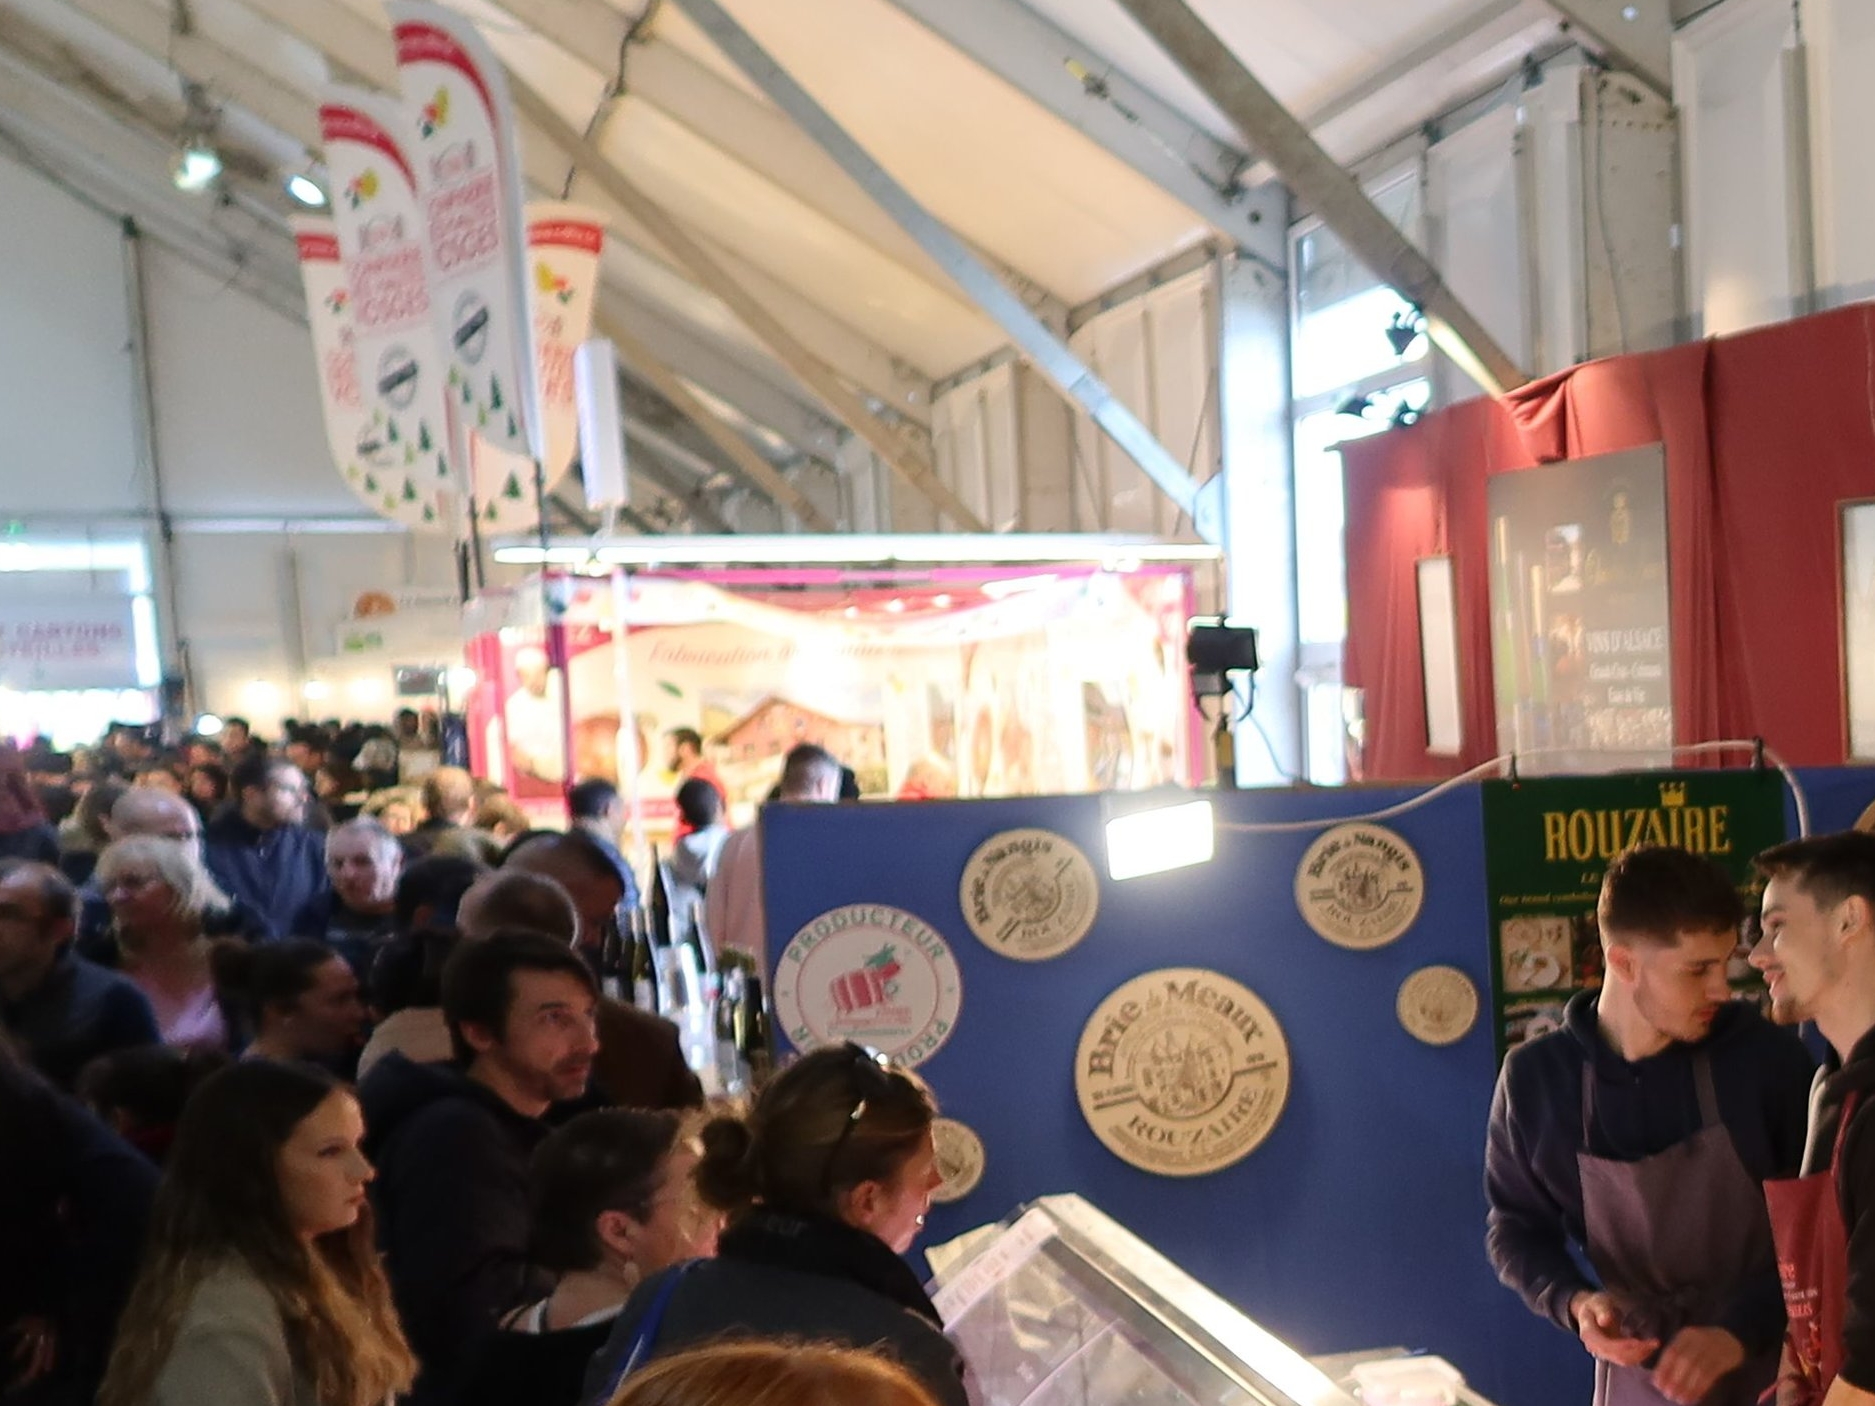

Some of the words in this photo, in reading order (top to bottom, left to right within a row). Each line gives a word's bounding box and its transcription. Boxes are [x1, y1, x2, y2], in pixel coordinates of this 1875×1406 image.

[1542, 804, 1733, 862] ROUZAIRE
[788, 908, 945, 963] PRODUCTEUR
[1088, 1001, 1144, 1079] Brie
[1163, 979, 1264, 1044] Meaux
[1126, 1087, 1259, 1146] ROUZAIRE
